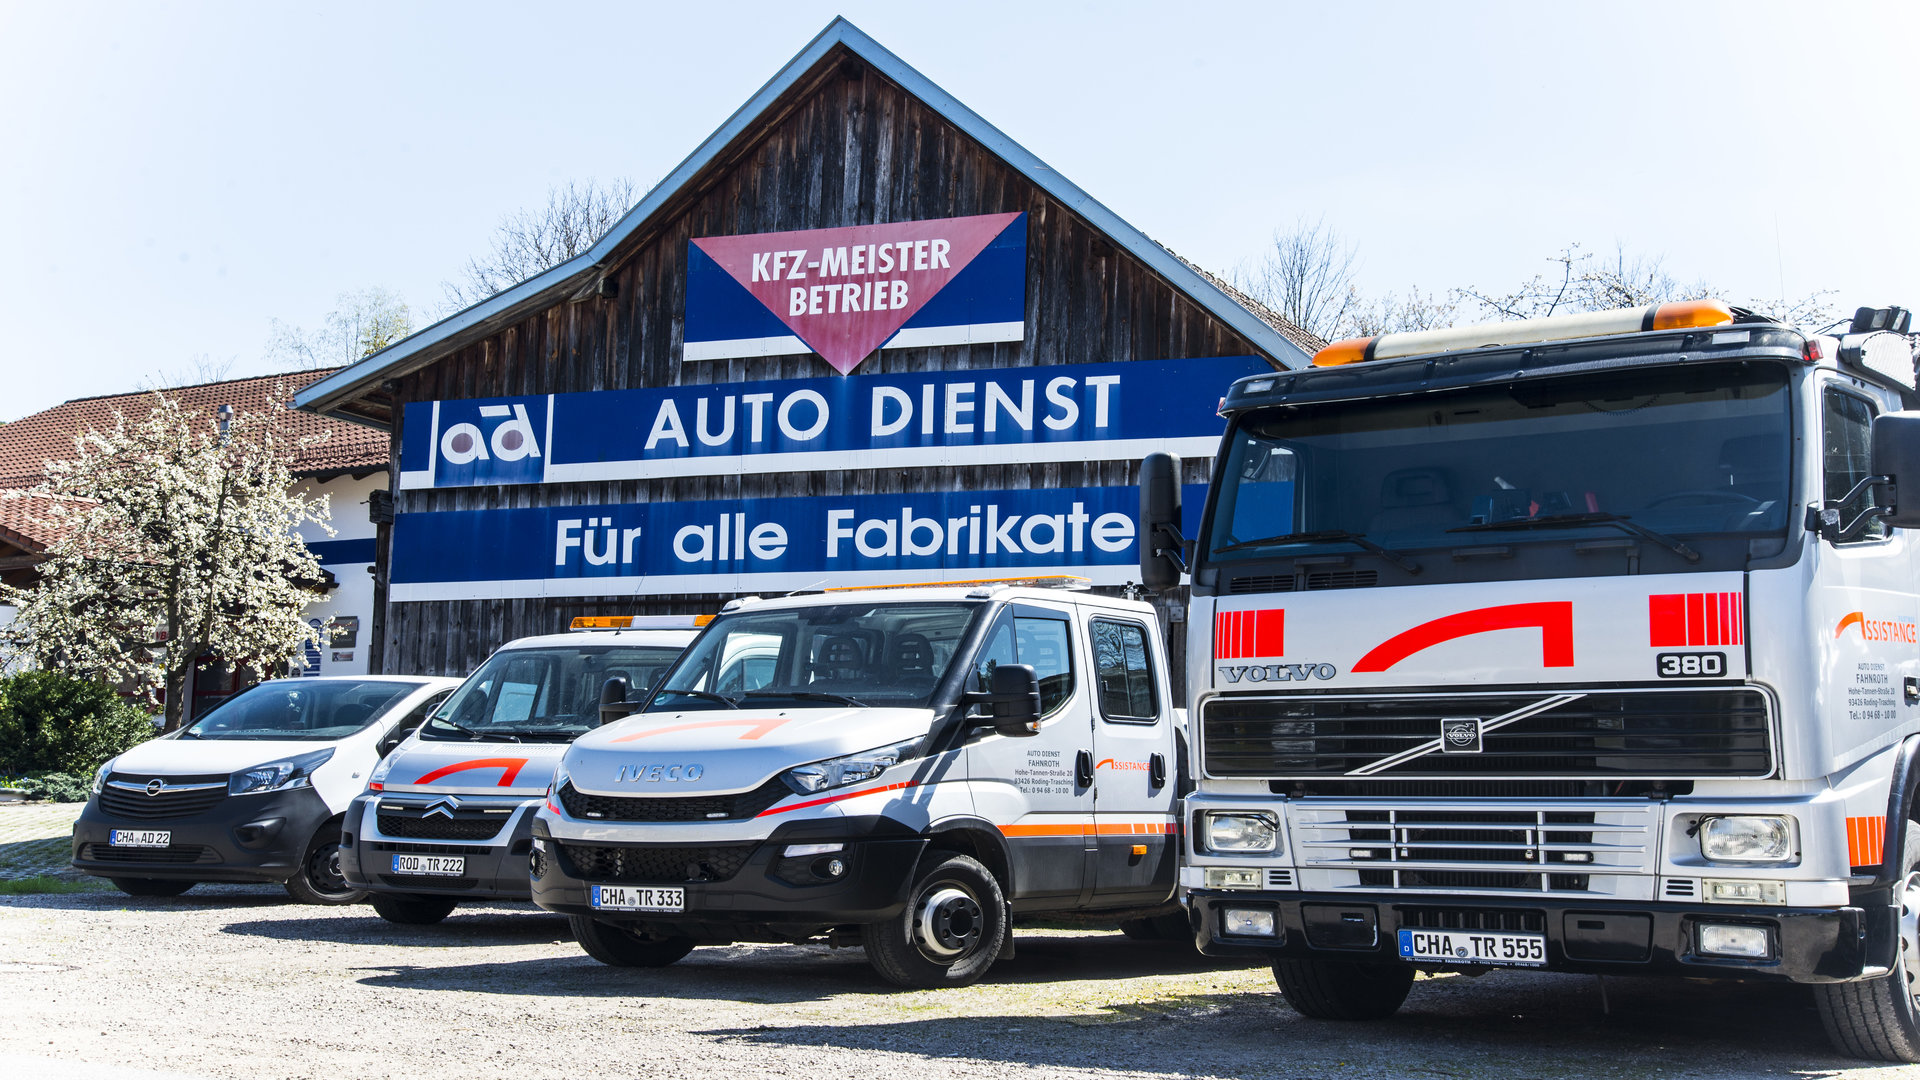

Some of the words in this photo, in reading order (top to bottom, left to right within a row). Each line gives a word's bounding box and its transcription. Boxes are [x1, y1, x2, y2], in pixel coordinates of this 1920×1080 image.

[752, 239, 951, 282] KFZ-MEISTER
[789, 280, 909, 316] BETRIEB
[644, 389, 830, 450] AUTO
[871, 375, 1120, 437] DIENST
[555, 517, 642, 566] Für
[673, 512, 788, 562] alle
[826, 502, 1135, 558] Fabrikate
[1218, 663, 1337, 683] VOLVO
[1661, 655, 1721, 675] 380
[1856, 674, 1888, 683] FAHNROTH
[1028, 760, 1060, 768] FAHNROTH
[1042, 750, 1061, 758] DIENST
[615, 763, 704, 783] IVECO
[116, 831, 135, 843] CHA
[140, 832, 155, 844] AD
[156, 832, 170, 844] 22
[400, 857, 419, 870] ROD
[427, 858, 440, 871] TR
[442, 858, 463, 872] 222
[601, 888, 626, 905] CHA
[636, 889, 653, 906] TR
[656, 889, 682, 907] 333
[1413, 933, 1453, 956] CHA
[1470, 936, 1498, 958] TR
[1502, 937, 1543, 960] 555
